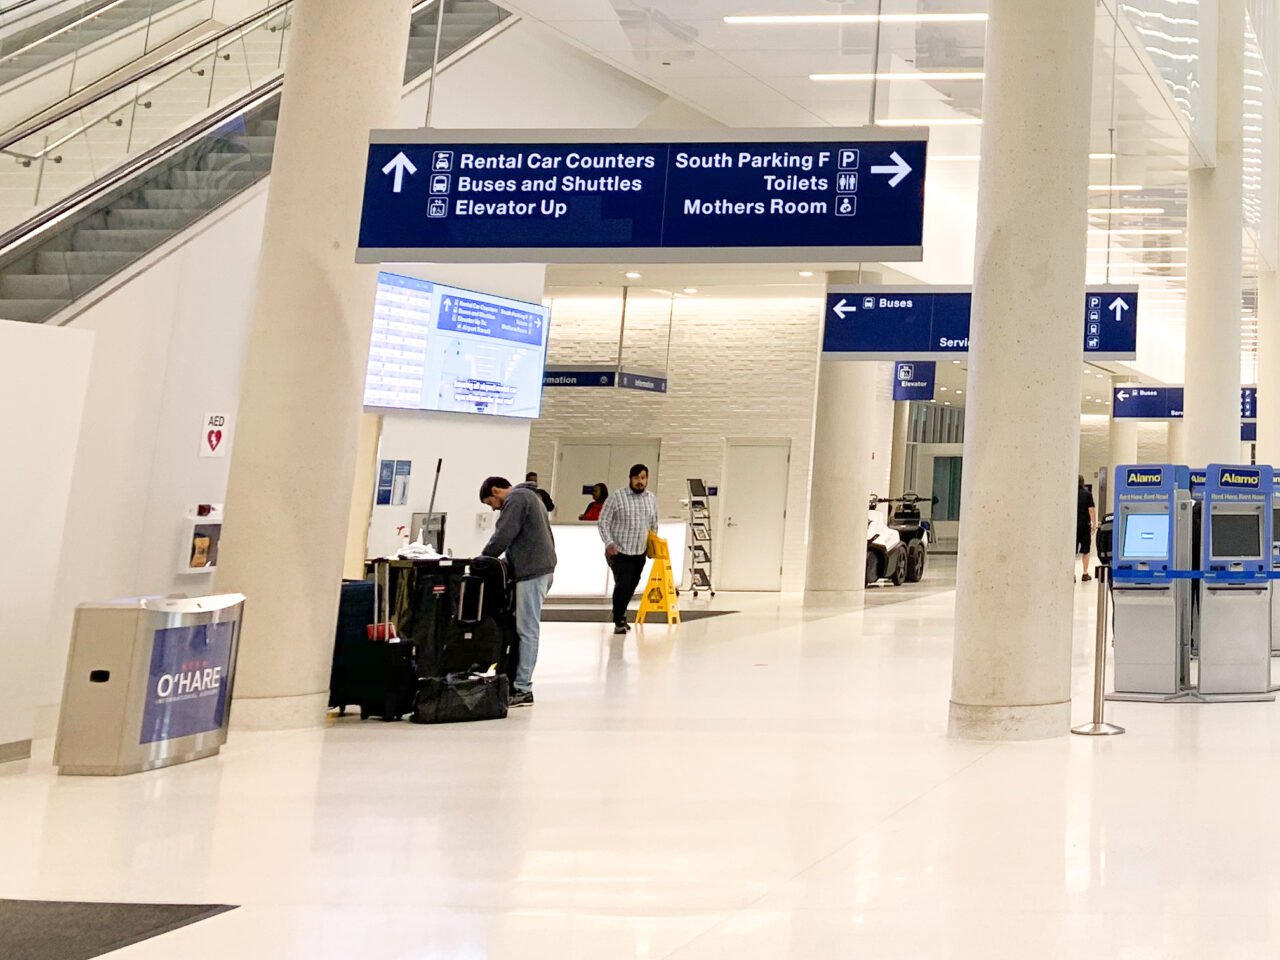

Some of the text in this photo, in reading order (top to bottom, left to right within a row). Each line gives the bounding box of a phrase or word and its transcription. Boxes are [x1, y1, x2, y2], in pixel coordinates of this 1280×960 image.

[460, 153, 655, 169] Rental Car Counters
[675, 152, 732, 168] South
[738, 152, 813, 170] Parking
[818, 152, 831, 167] F
[457, 175, 642, 192] Buses and Shuttles
[763, 175, 829, 191] Toilets
[455, 199, 567, 218] Elevator Up
[683, 198, 827, 215] Mothers Room
[879, 298, 913, 308] Buses
[939, 337, 969, 347] Servi
[543, 376, 577, 384] rmation
[208, 415, 225, 427] AED
[1128, 472, 1161, 483] Alamo
[1221, 473, 1258, 484] Alamo
[157, 665, 222, 698] O'HARE
